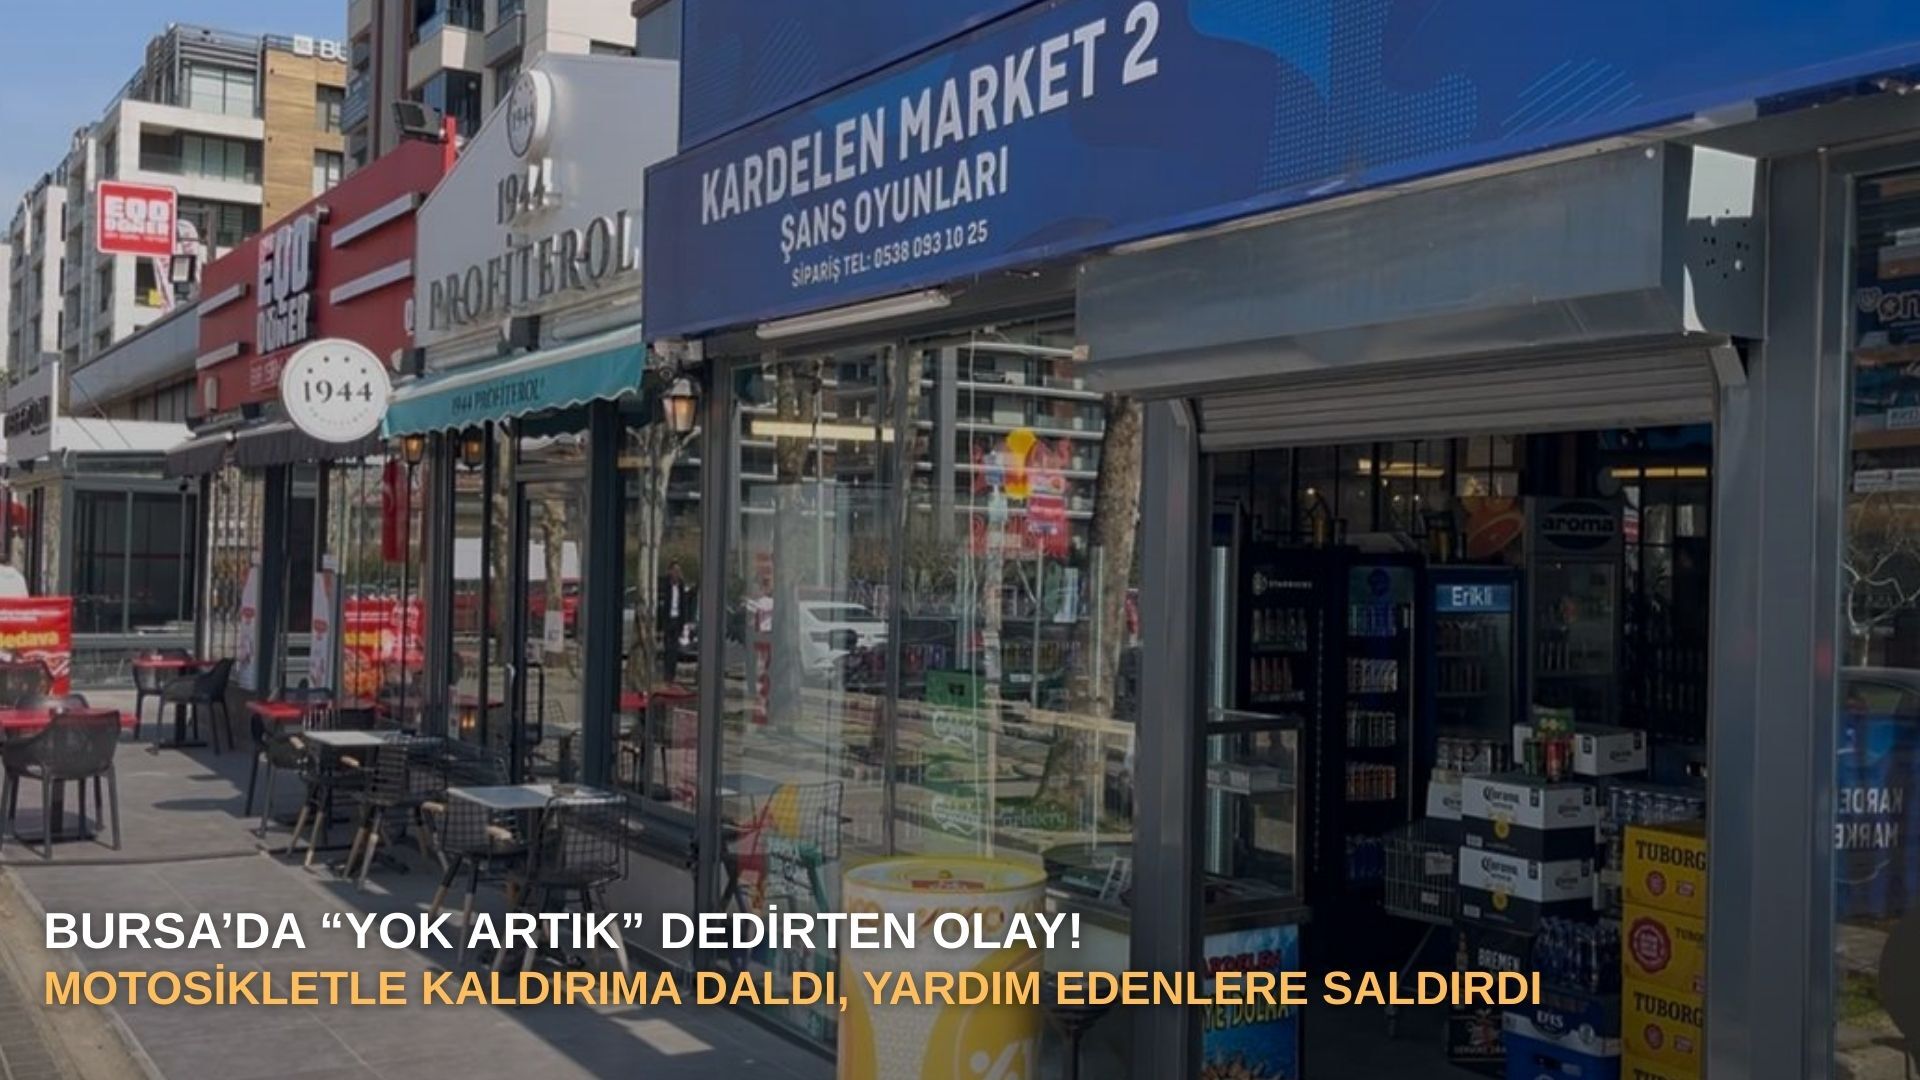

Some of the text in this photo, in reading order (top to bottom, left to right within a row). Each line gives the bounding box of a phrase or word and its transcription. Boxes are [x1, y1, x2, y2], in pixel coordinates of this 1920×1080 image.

[702, 0, 1159, 225] KARDELEN MARKET 2
[781, 146, 1008, 263] ŞANS OYUNLARI
[429, 210, 637, 330] PROFİTEROL
[792, 219, 989, 287] SİPARİŞ TEL: 0538 093 10 25
[304, 381, 372, 404] 1944
[1542, 517, 1615, 533] aroma
[0, 630, 60, 650] edava
[1636, 839, 1707, 872] TUBORG
[1633, 990, 1704, 1028] TUBORG
